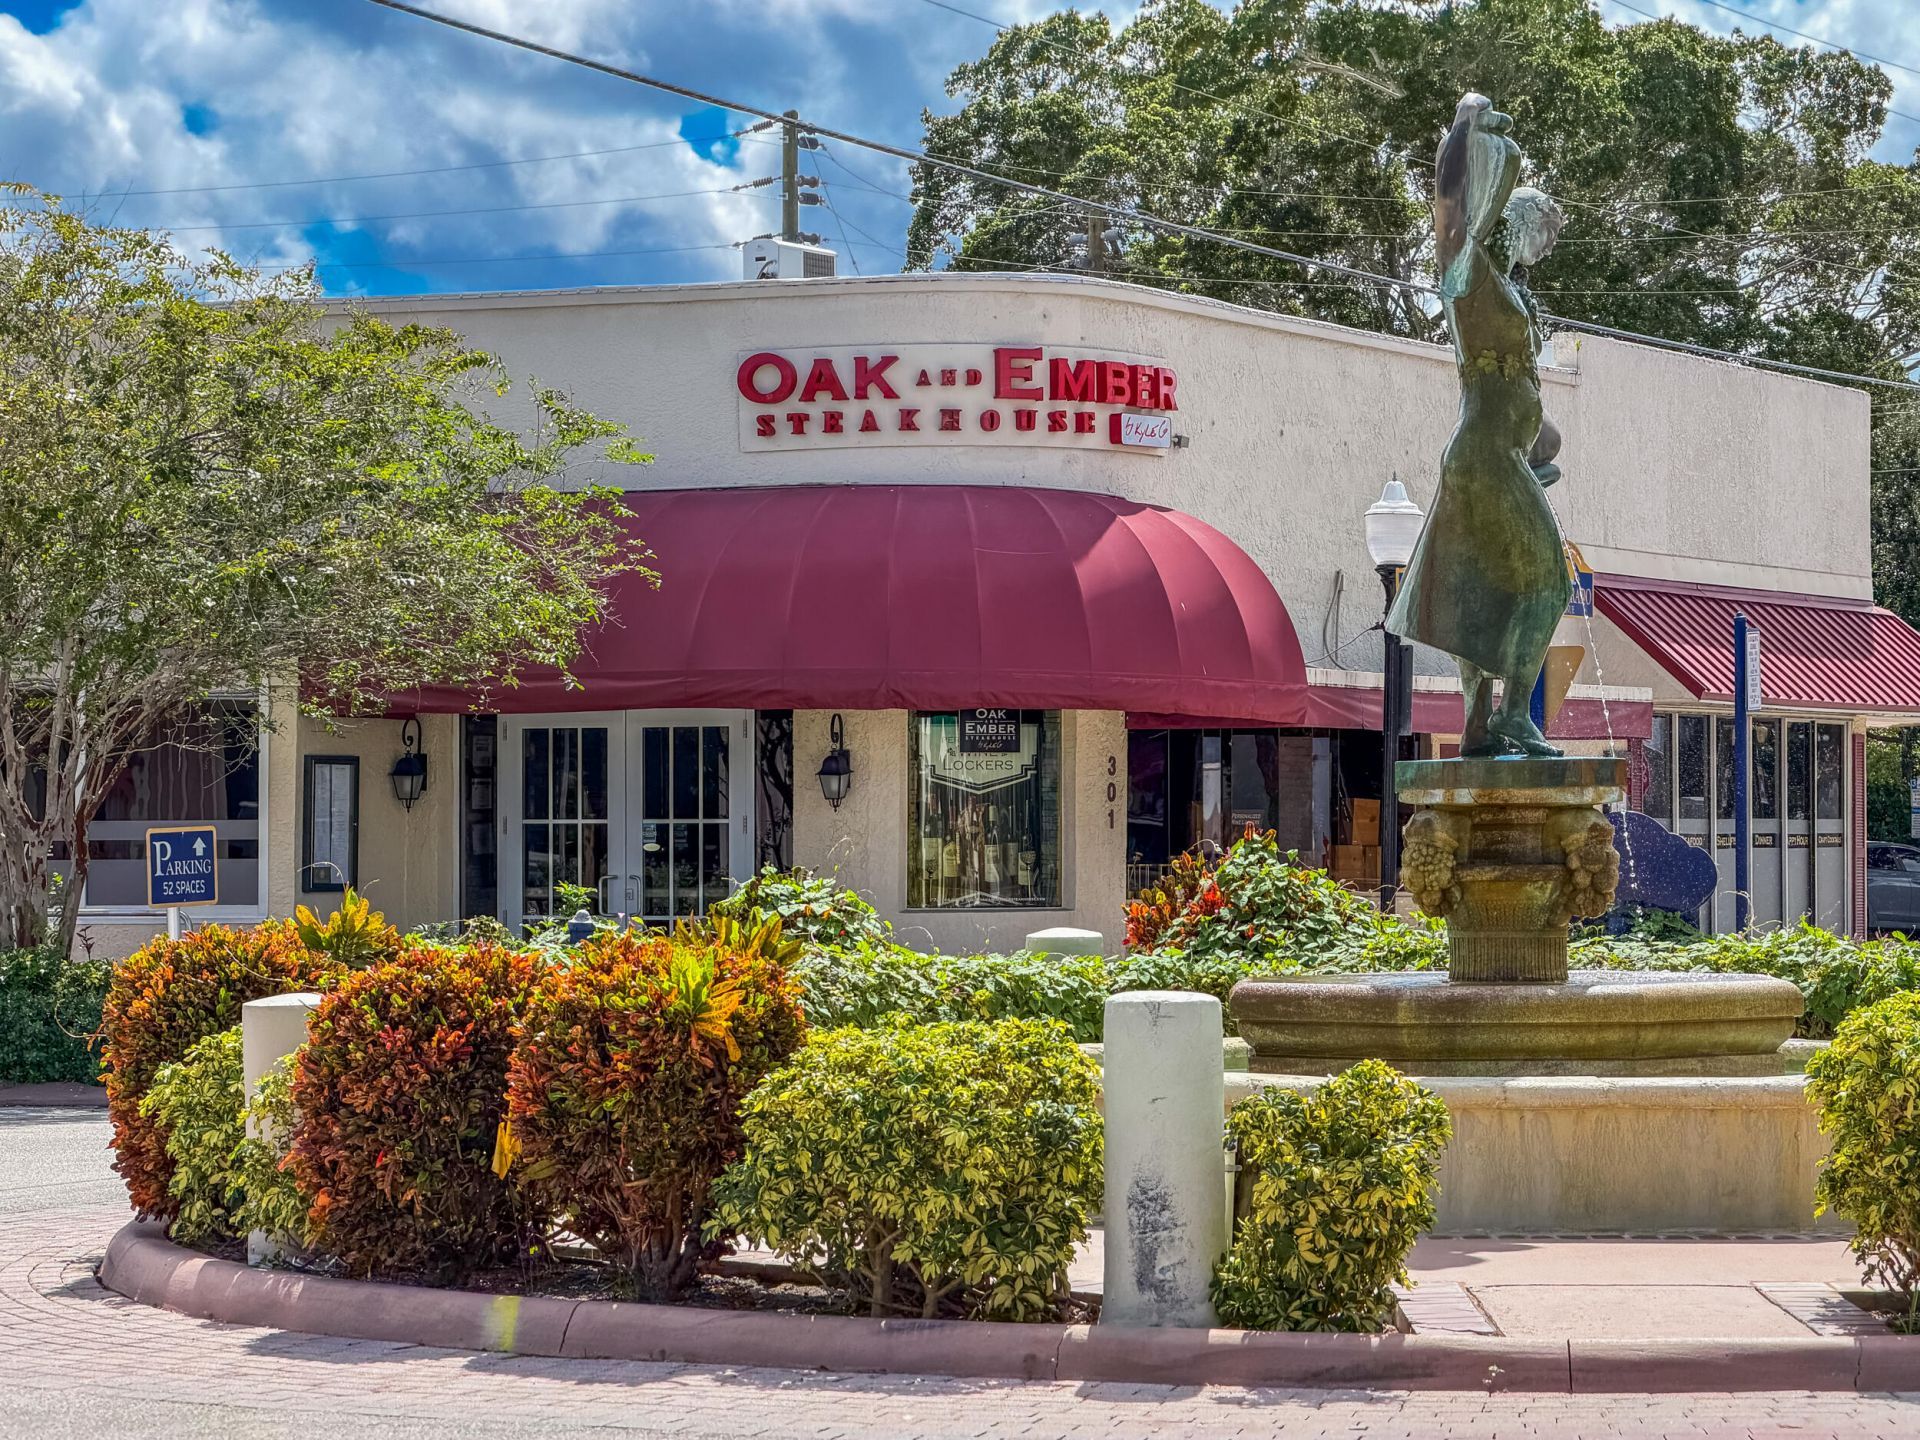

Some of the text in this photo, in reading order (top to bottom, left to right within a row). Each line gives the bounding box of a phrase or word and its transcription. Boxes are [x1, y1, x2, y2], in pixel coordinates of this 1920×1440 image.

[737, 346, 1179, 411] OAK AND EMBER
[756, 408, 1096, 437] STEAKHOUSE
[975, 708, 1007, 719] OAK
[965, 722, 1016, 734] EMBER
[943, 760, 1014, 771] LOCKERS
[1107, 756, 1117, 829] 301
[1755, 835, 1773, 845] DINNER
[152, 840, 212, 877] PARKING
[163, 879, 206, 895] 52 SPACES
